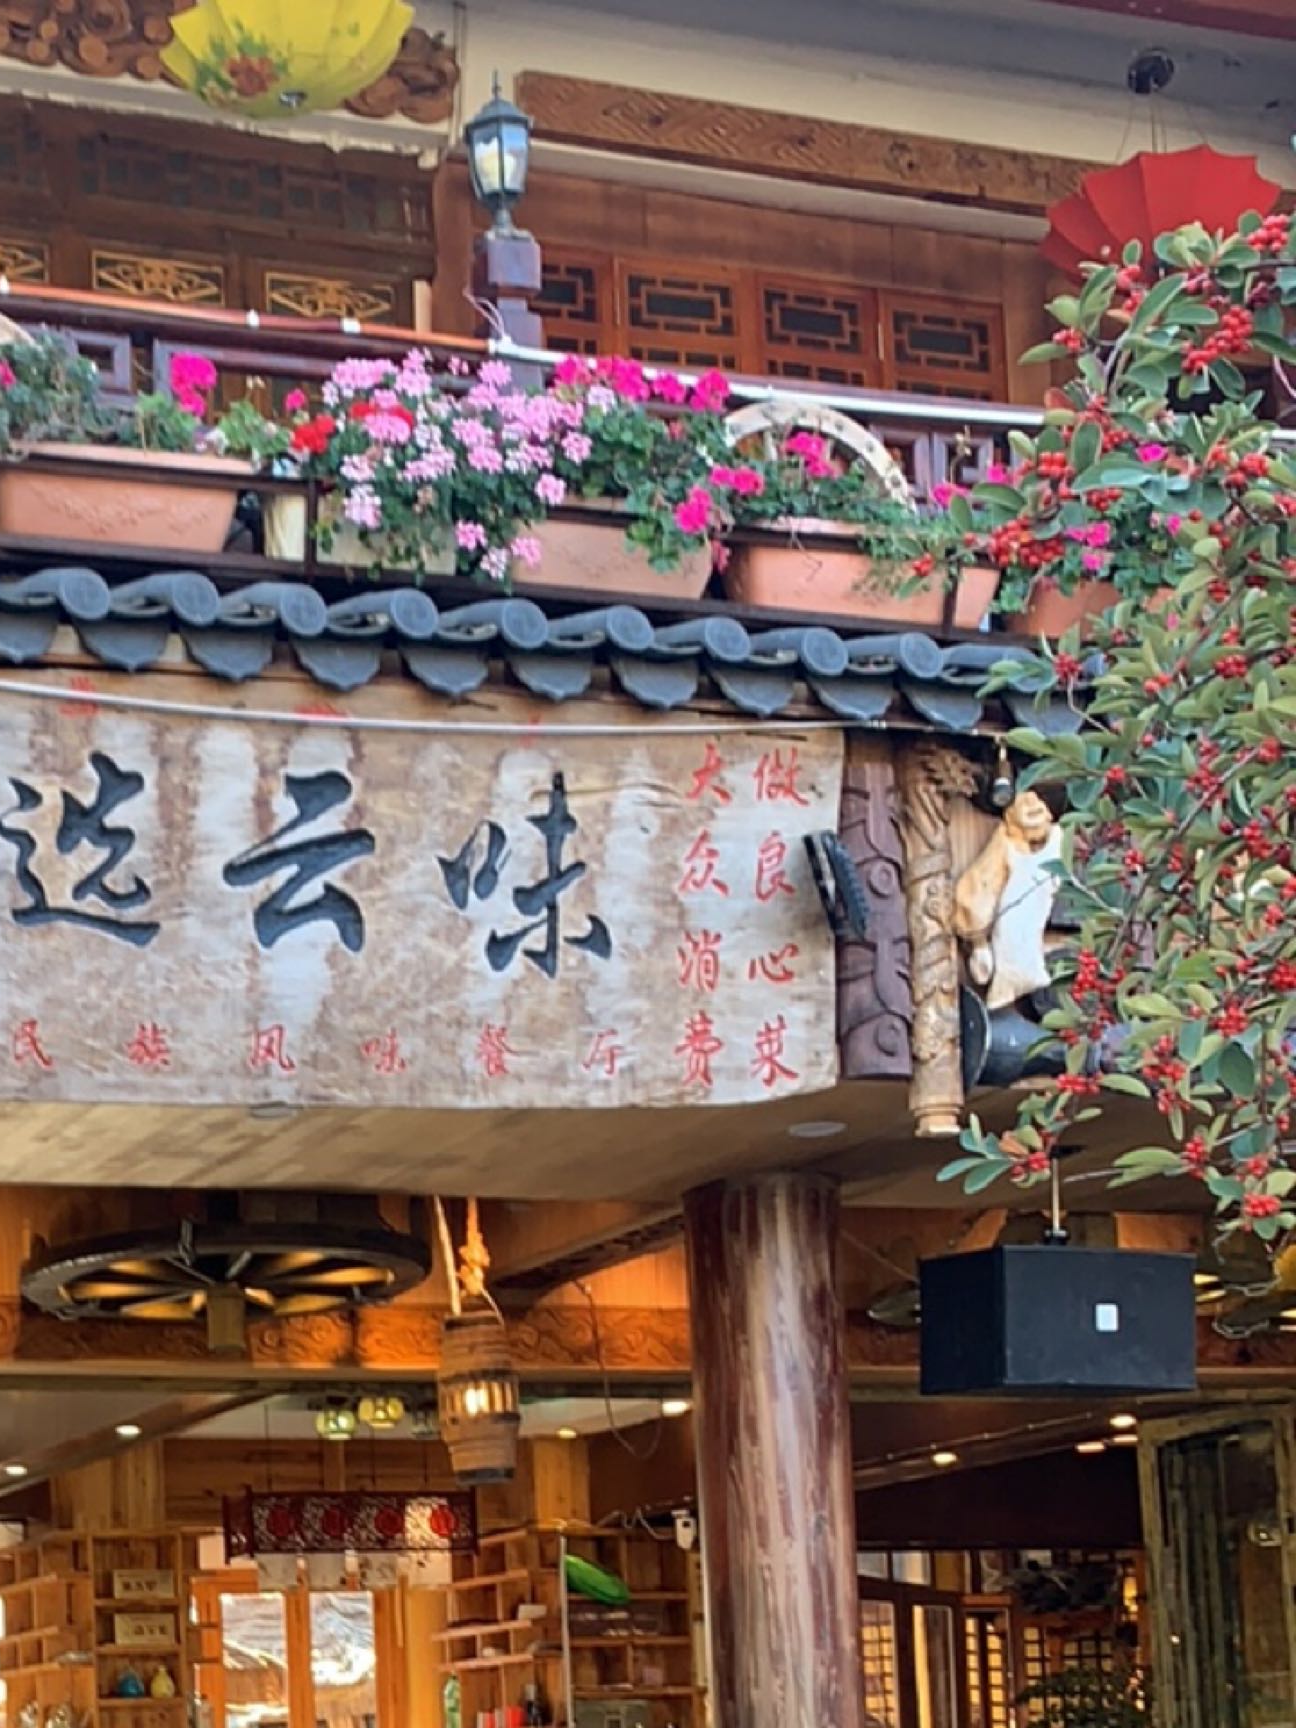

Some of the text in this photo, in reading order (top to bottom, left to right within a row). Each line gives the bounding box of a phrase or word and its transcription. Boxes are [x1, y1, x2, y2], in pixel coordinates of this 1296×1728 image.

[674, 742, 733, 1087] 大众消费
[748, 746, 810, 1088] 做良心菜
